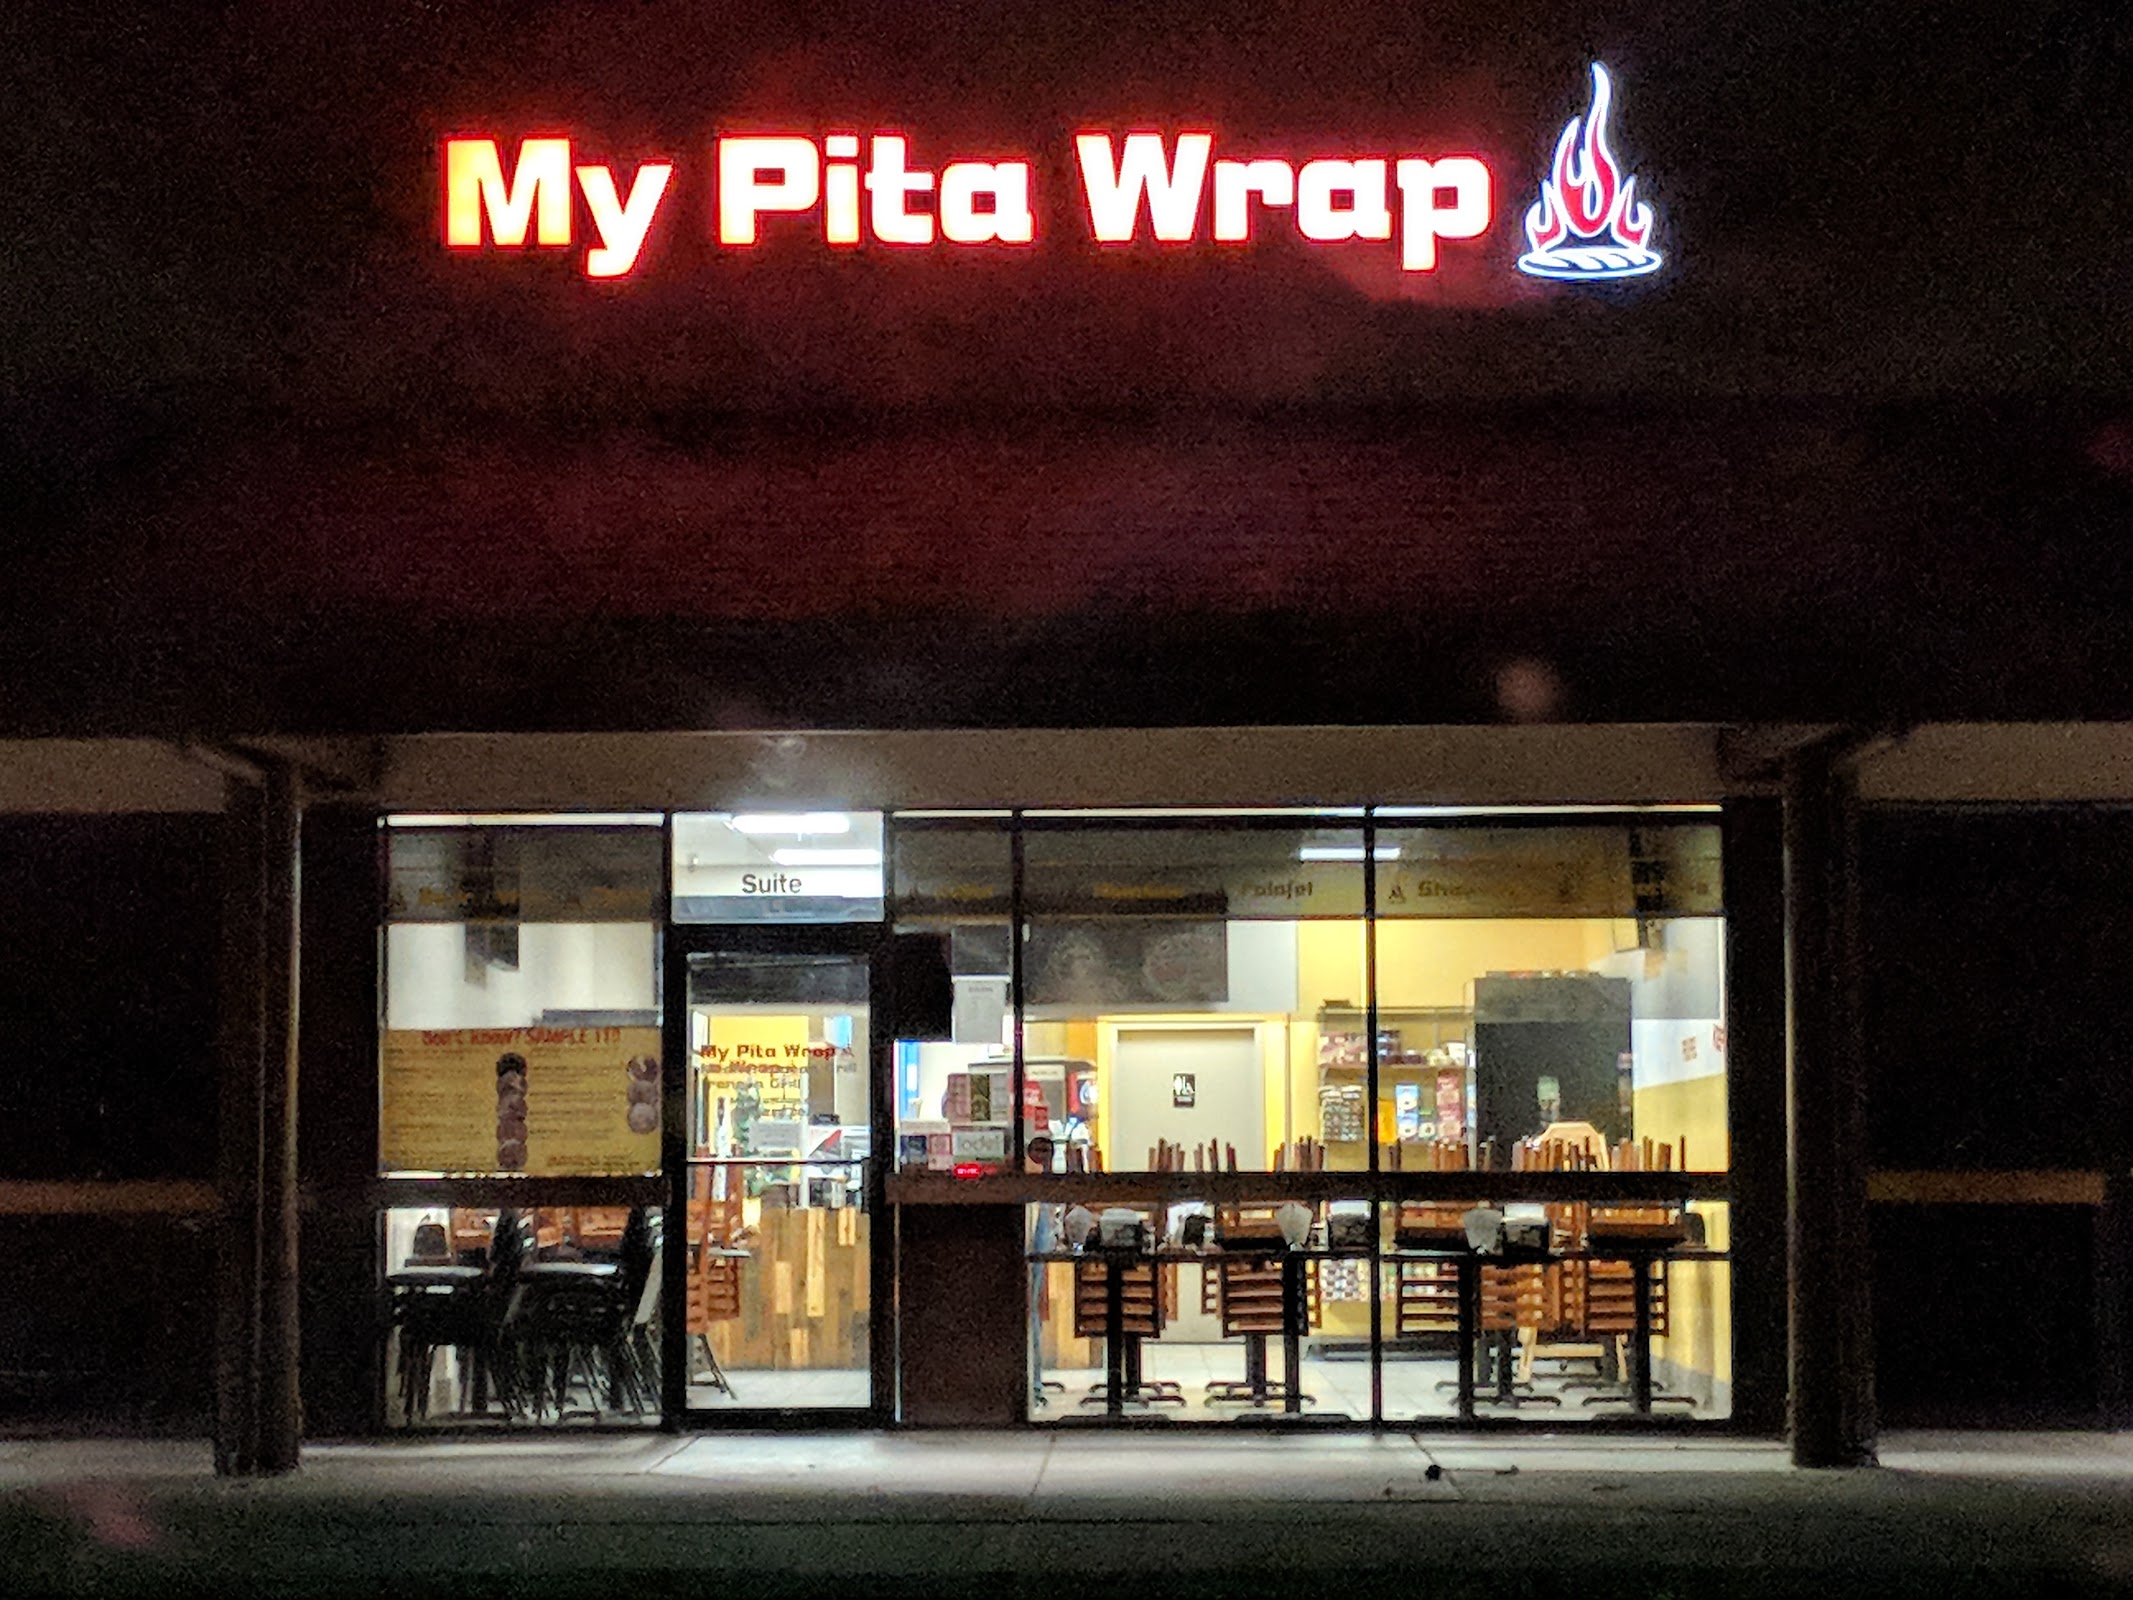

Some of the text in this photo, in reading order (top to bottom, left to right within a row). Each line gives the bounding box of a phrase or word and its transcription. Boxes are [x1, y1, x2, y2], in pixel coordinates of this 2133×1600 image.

[444, 131, 1495, 279] My Pita Wrap
[742, 872, 802, 894] Suite
[701, 1044, 836, 1062] My Pita Wrap
